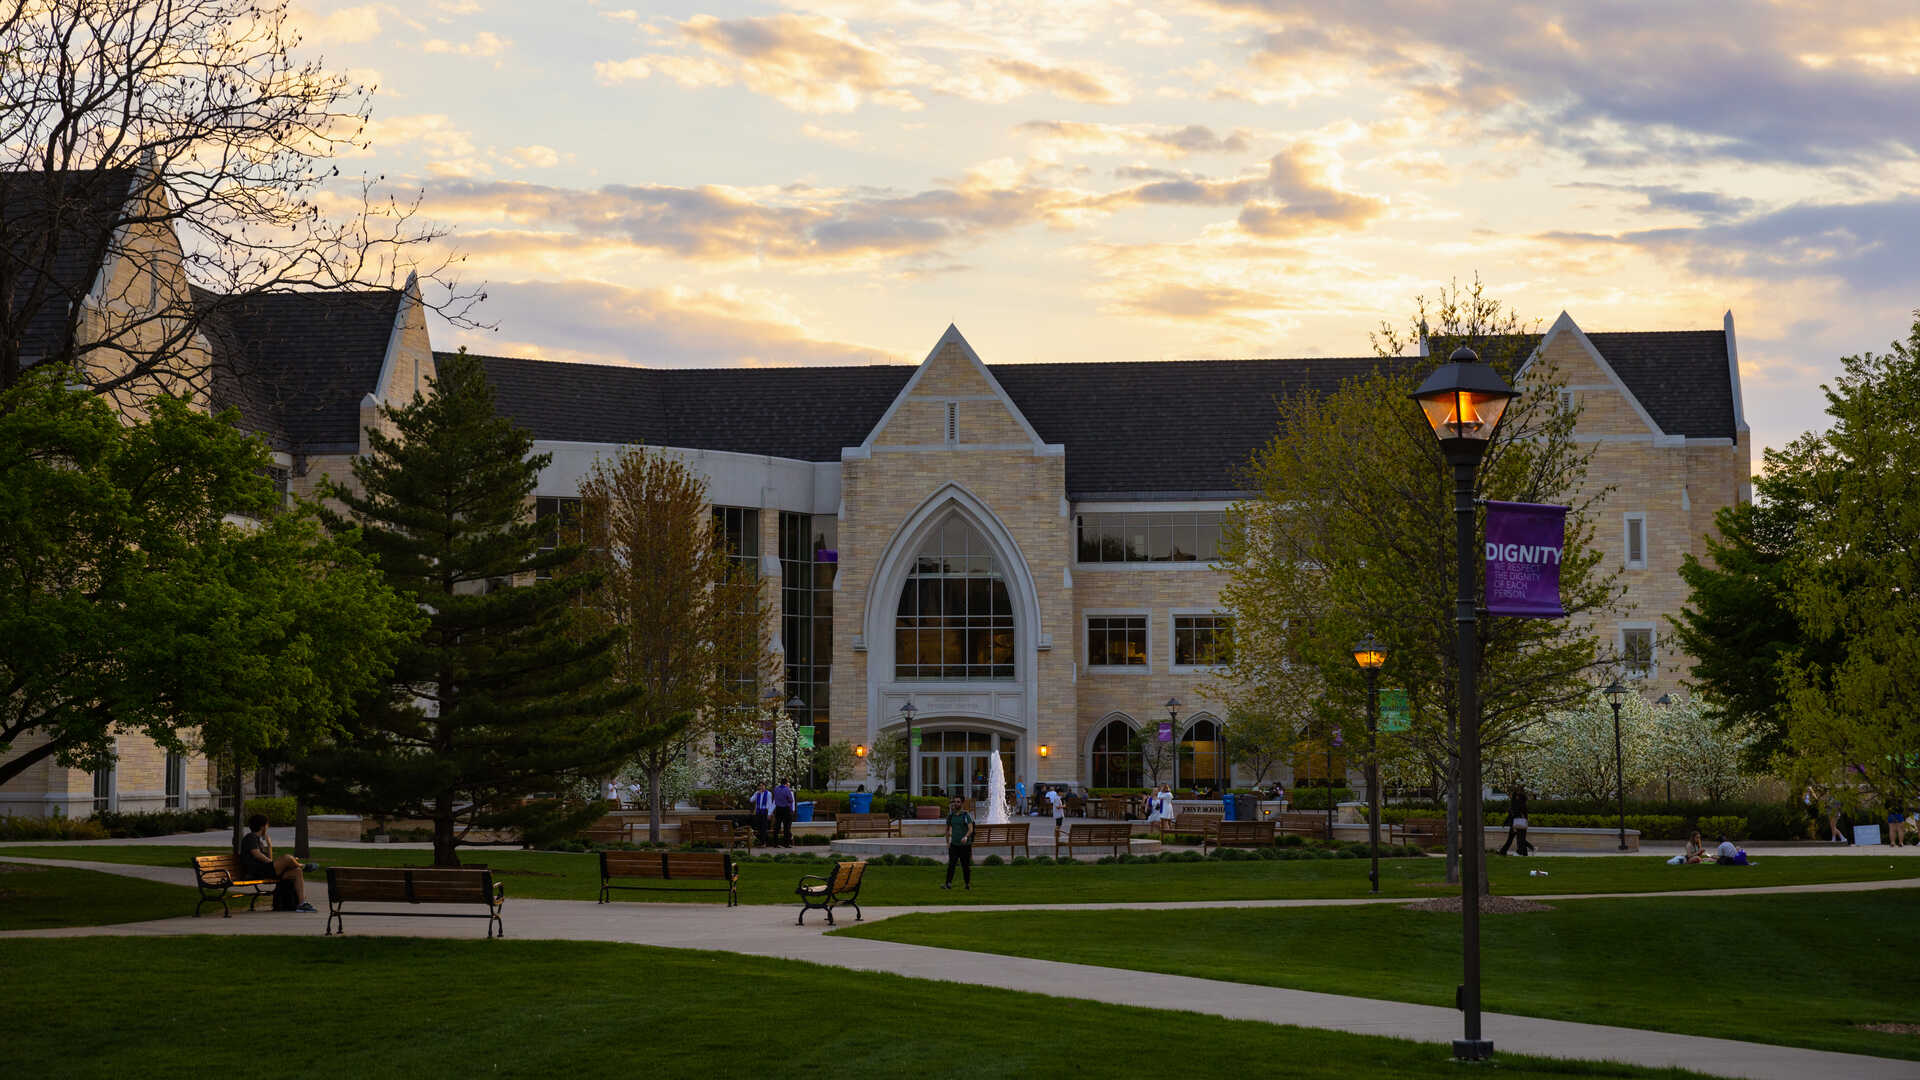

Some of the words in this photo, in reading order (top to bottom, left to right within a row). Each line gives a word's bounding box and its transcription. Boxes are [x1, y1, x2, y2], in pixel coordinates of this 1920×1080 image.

[1485, 542, 1562, 565] DIGNITY
[1494, 571, 1508, 580] THE
[1509, 571, 1541, 582] DIGNITY
[1506, 580, 1528, 590] EACH
